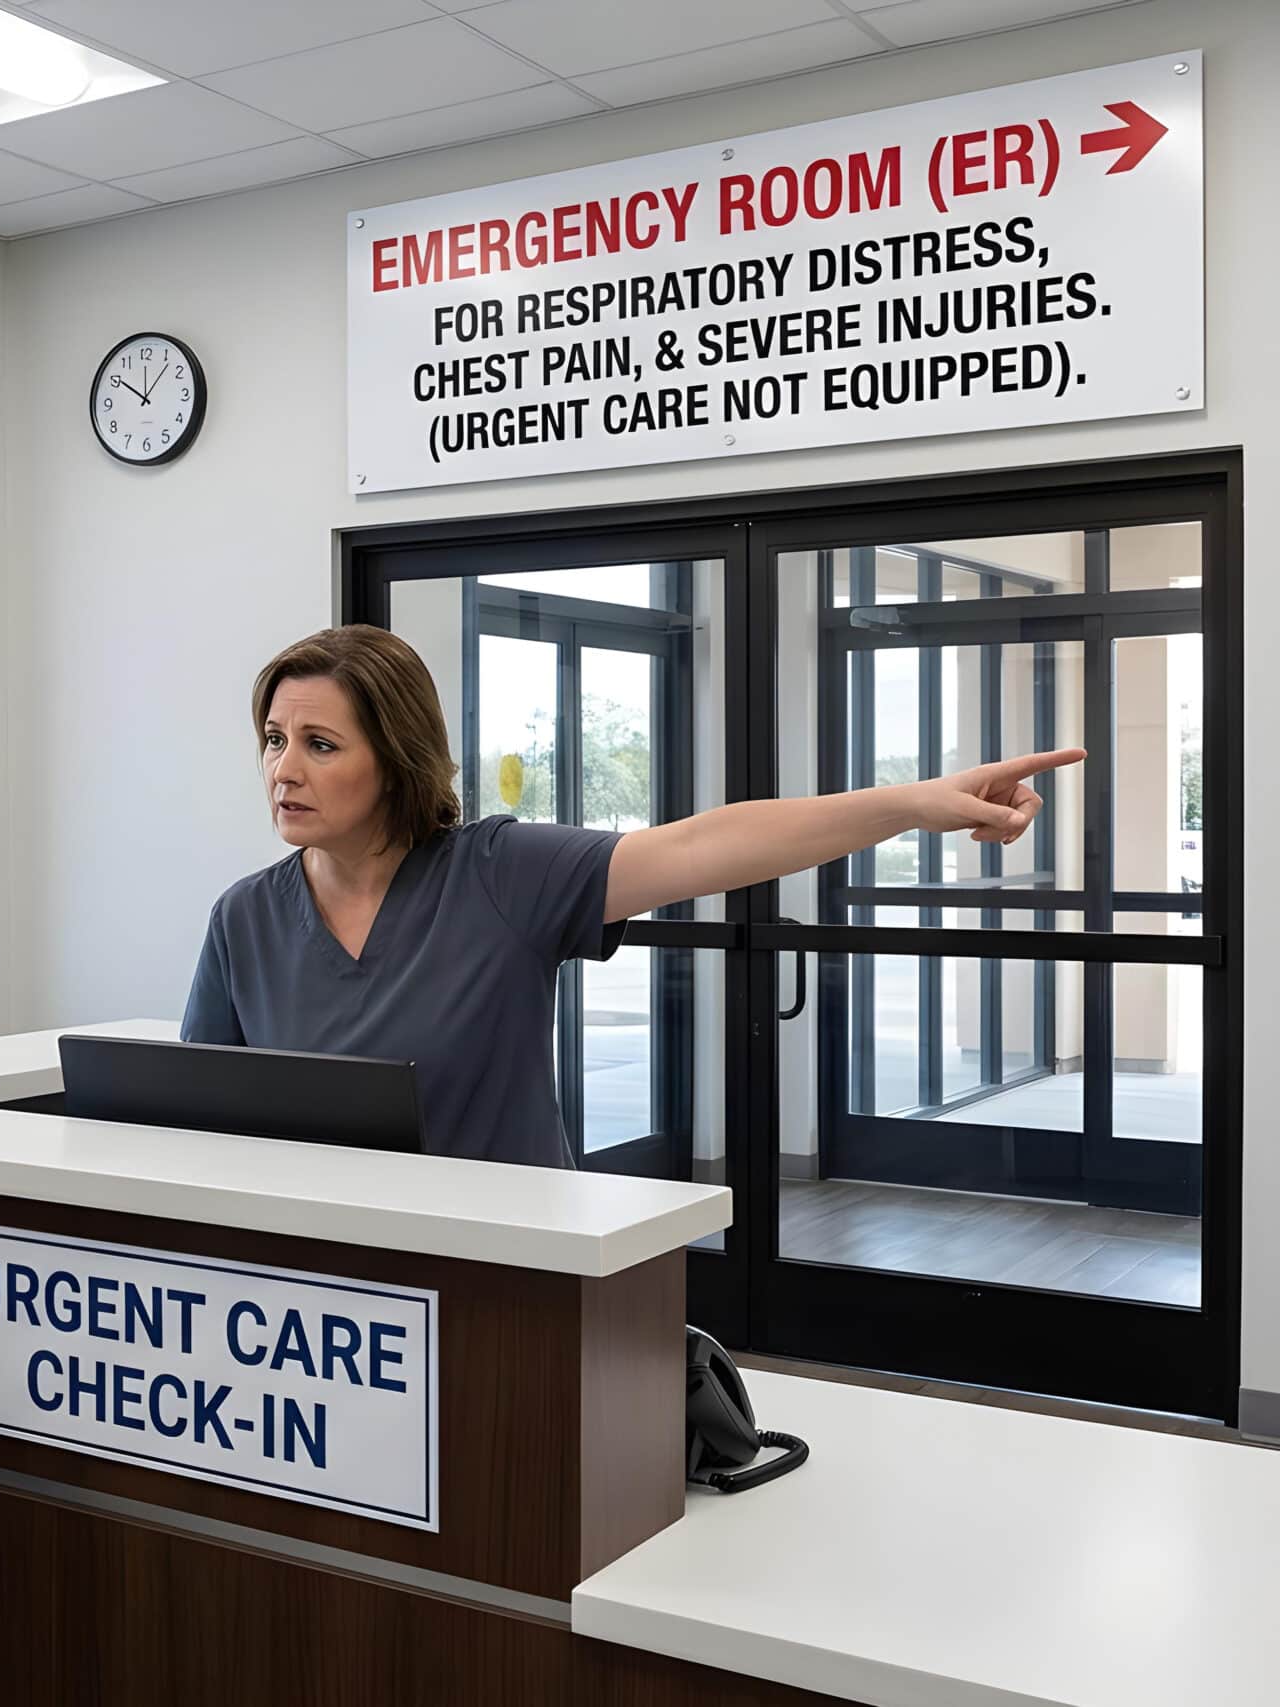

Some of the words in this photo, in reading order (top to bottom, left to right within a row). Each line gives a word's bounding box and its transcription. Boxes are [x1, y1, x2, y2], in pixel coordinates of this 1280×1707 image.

[372, 183, 698, 293] EMERGENCY
[719, 146, 902, 236] ROOM
[927, 118, 1061, 214] (ER)
[414, 350, 530, 402] CHEST
[543, 335, 642, 386] PAIN,
[655, 330, 686, 372] &
[698, 303, 862, 366] SEVERE
[878, 272, 1111, 344] INJURIES.
[434, 299, 505, 346] FOR
[518, 253, 794, 334] RESPIRATORY
[809, 216, 1050, 292] DISTRESS,
[429, 398, 590, 463] (URGENT
[603, 383, 709, 435] CARE
[723, 371, 808, 423] NOT
[823, 341, 1086, 412] EQUIPPED).
[27, 1349, 327, 1470] CHECK-IN
[226, 1300, 407, 1394] CARE
